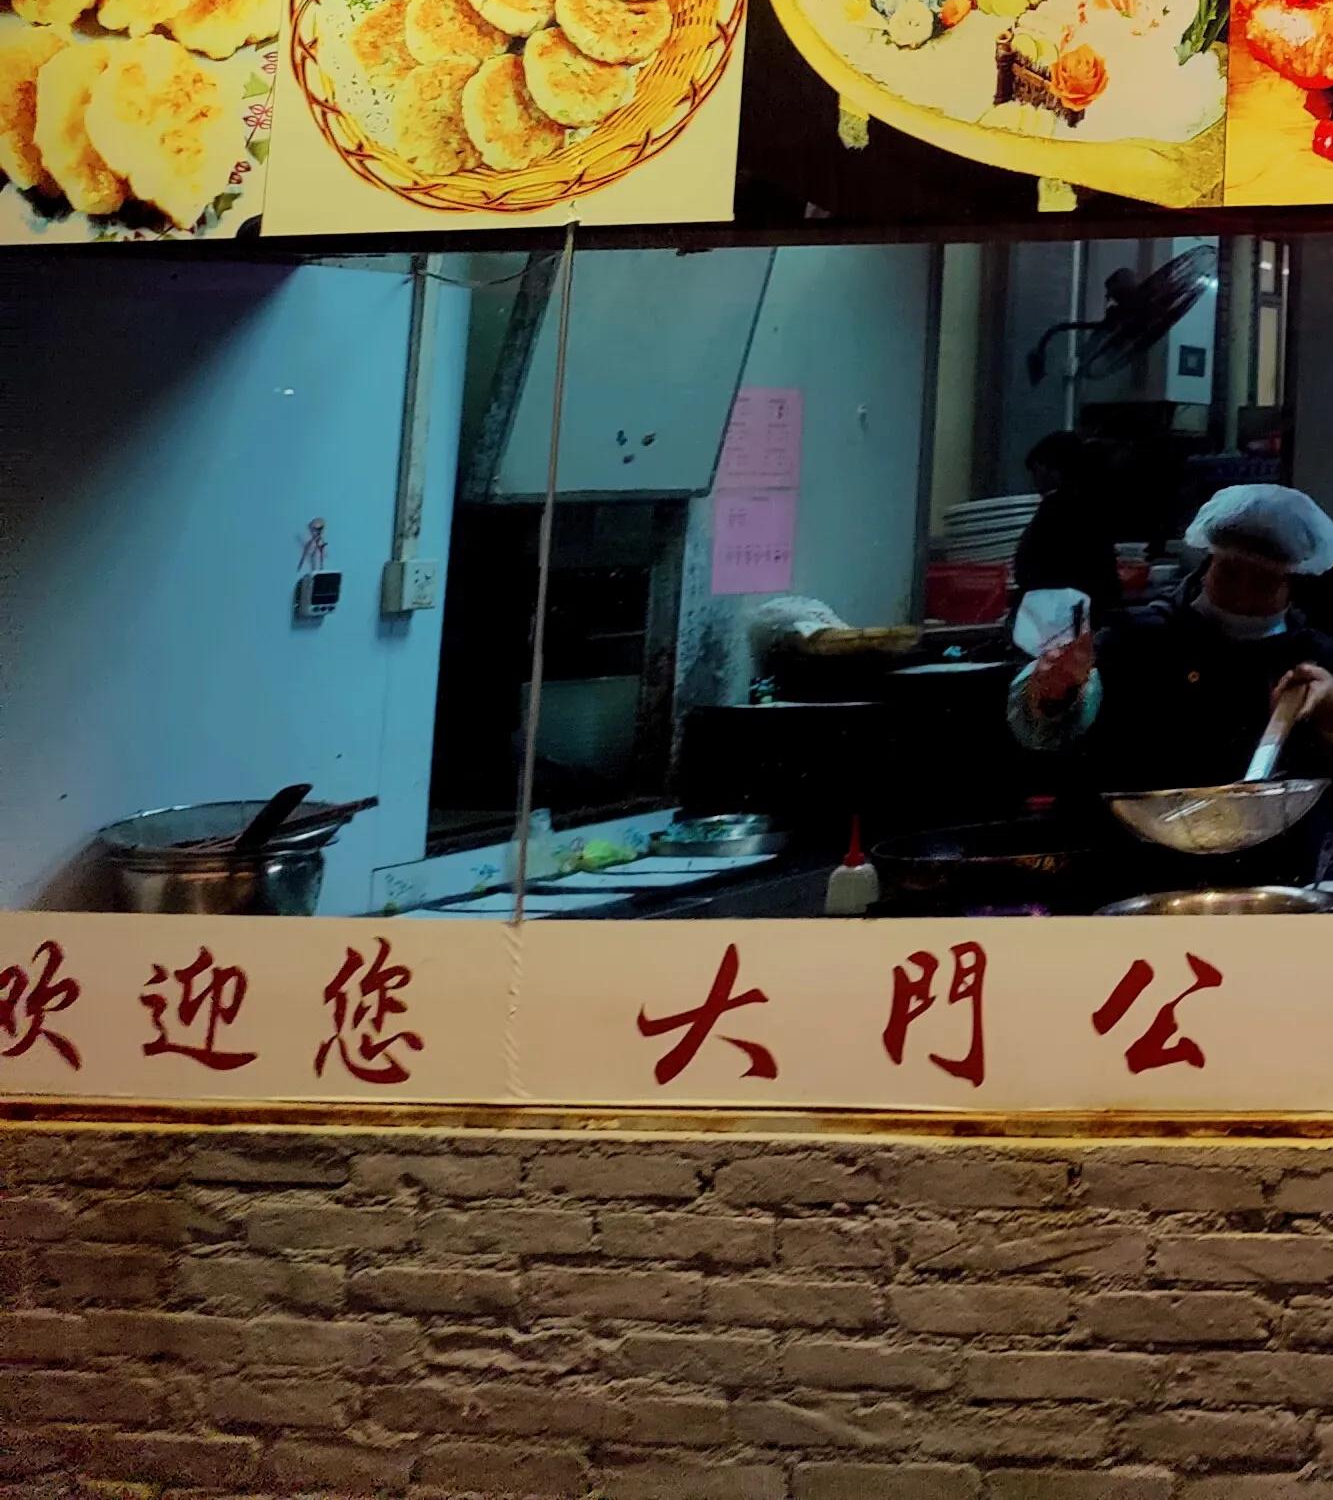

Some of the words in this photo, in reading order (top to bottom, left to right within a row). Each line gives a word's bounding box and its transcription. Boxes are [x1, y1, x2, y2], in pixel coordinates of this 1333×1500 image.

[0, 937, 424, 1085] 欢迎您
[637, 941, 1224, 1088] 大門公
